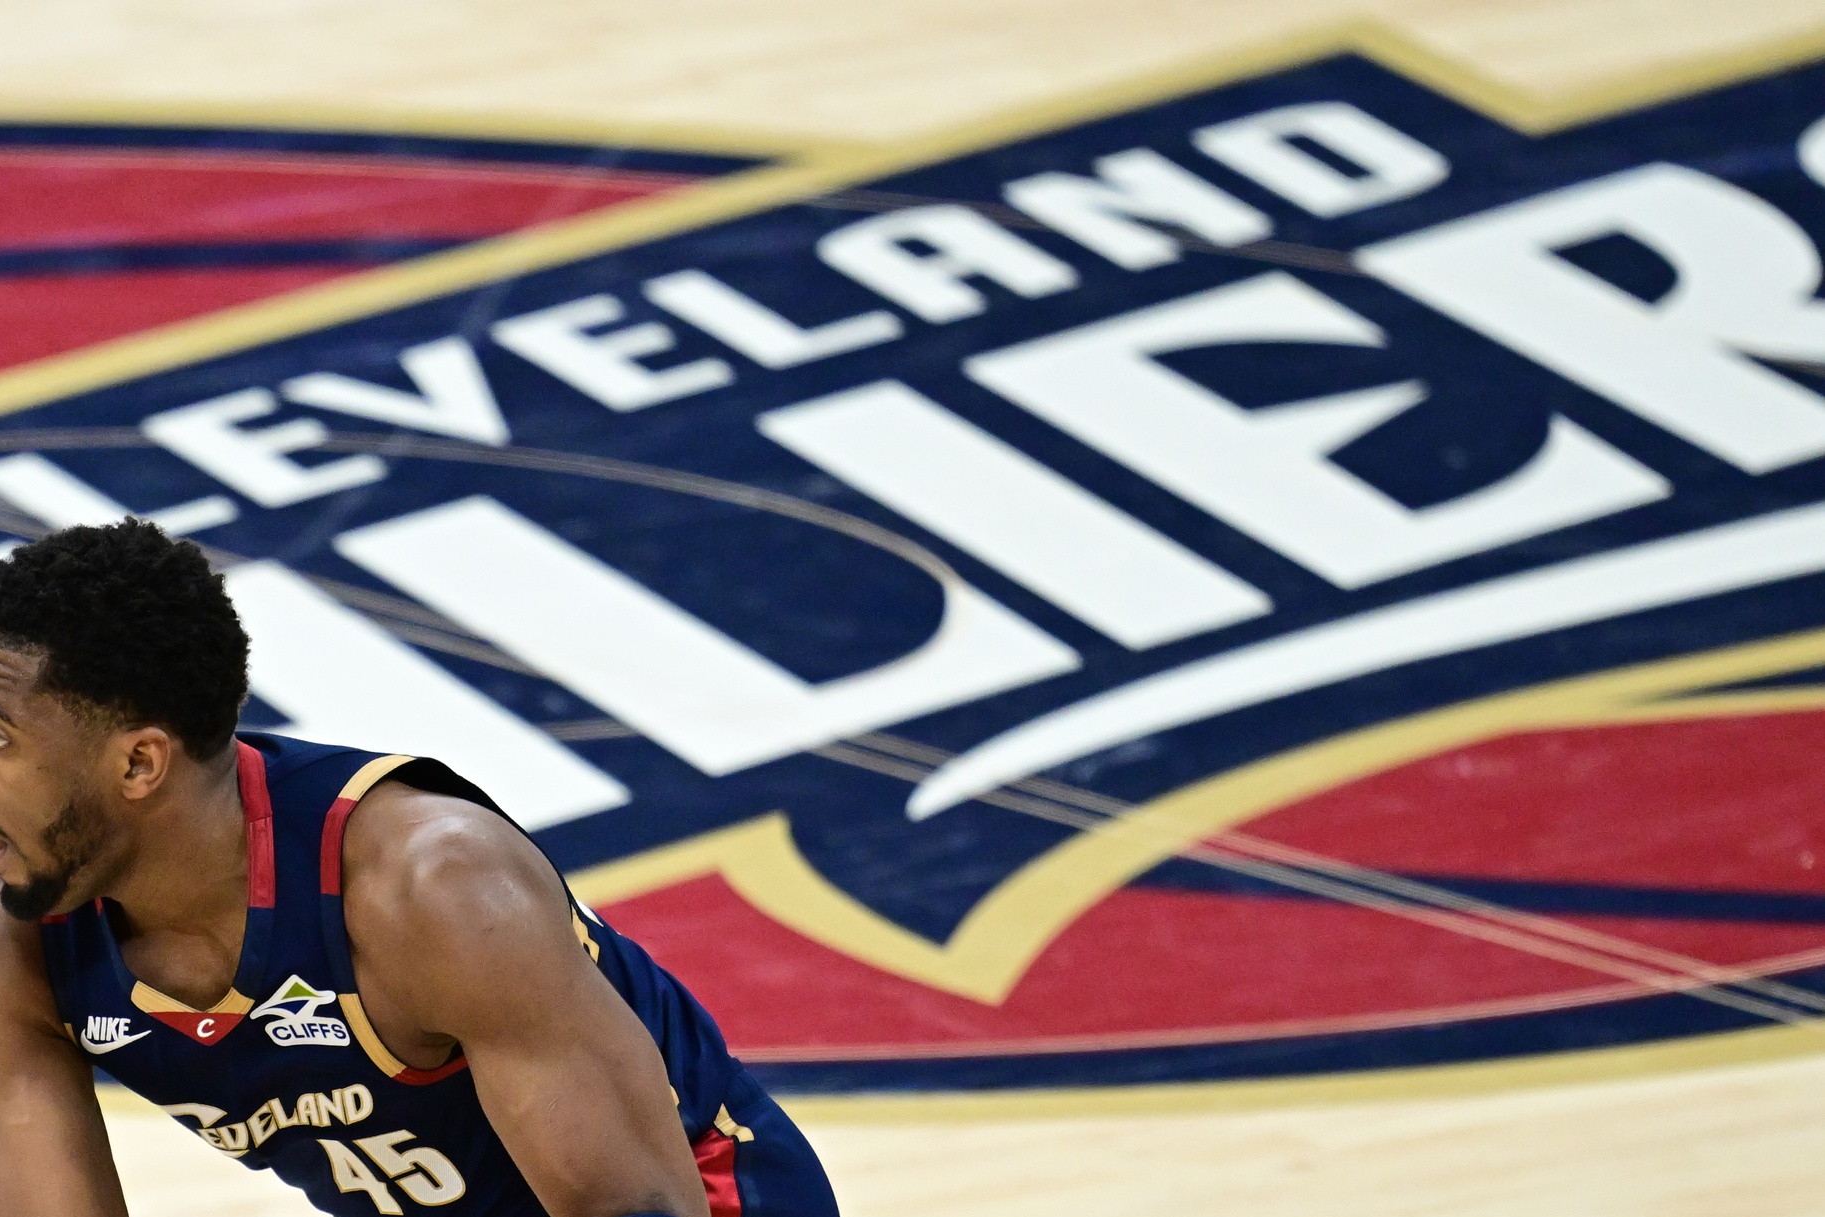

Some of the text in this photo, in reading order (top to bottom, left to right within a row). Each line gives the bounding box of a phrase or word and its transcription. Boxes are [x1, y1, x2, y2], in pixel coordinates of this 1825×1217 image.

[86, 1015, 132, 1042] NIKE
[271, 1023, 347, 1041] CLIFFS
[160, 1083, 374, 1159] EVELAND
[316, 1129, 467, 1216] 45
